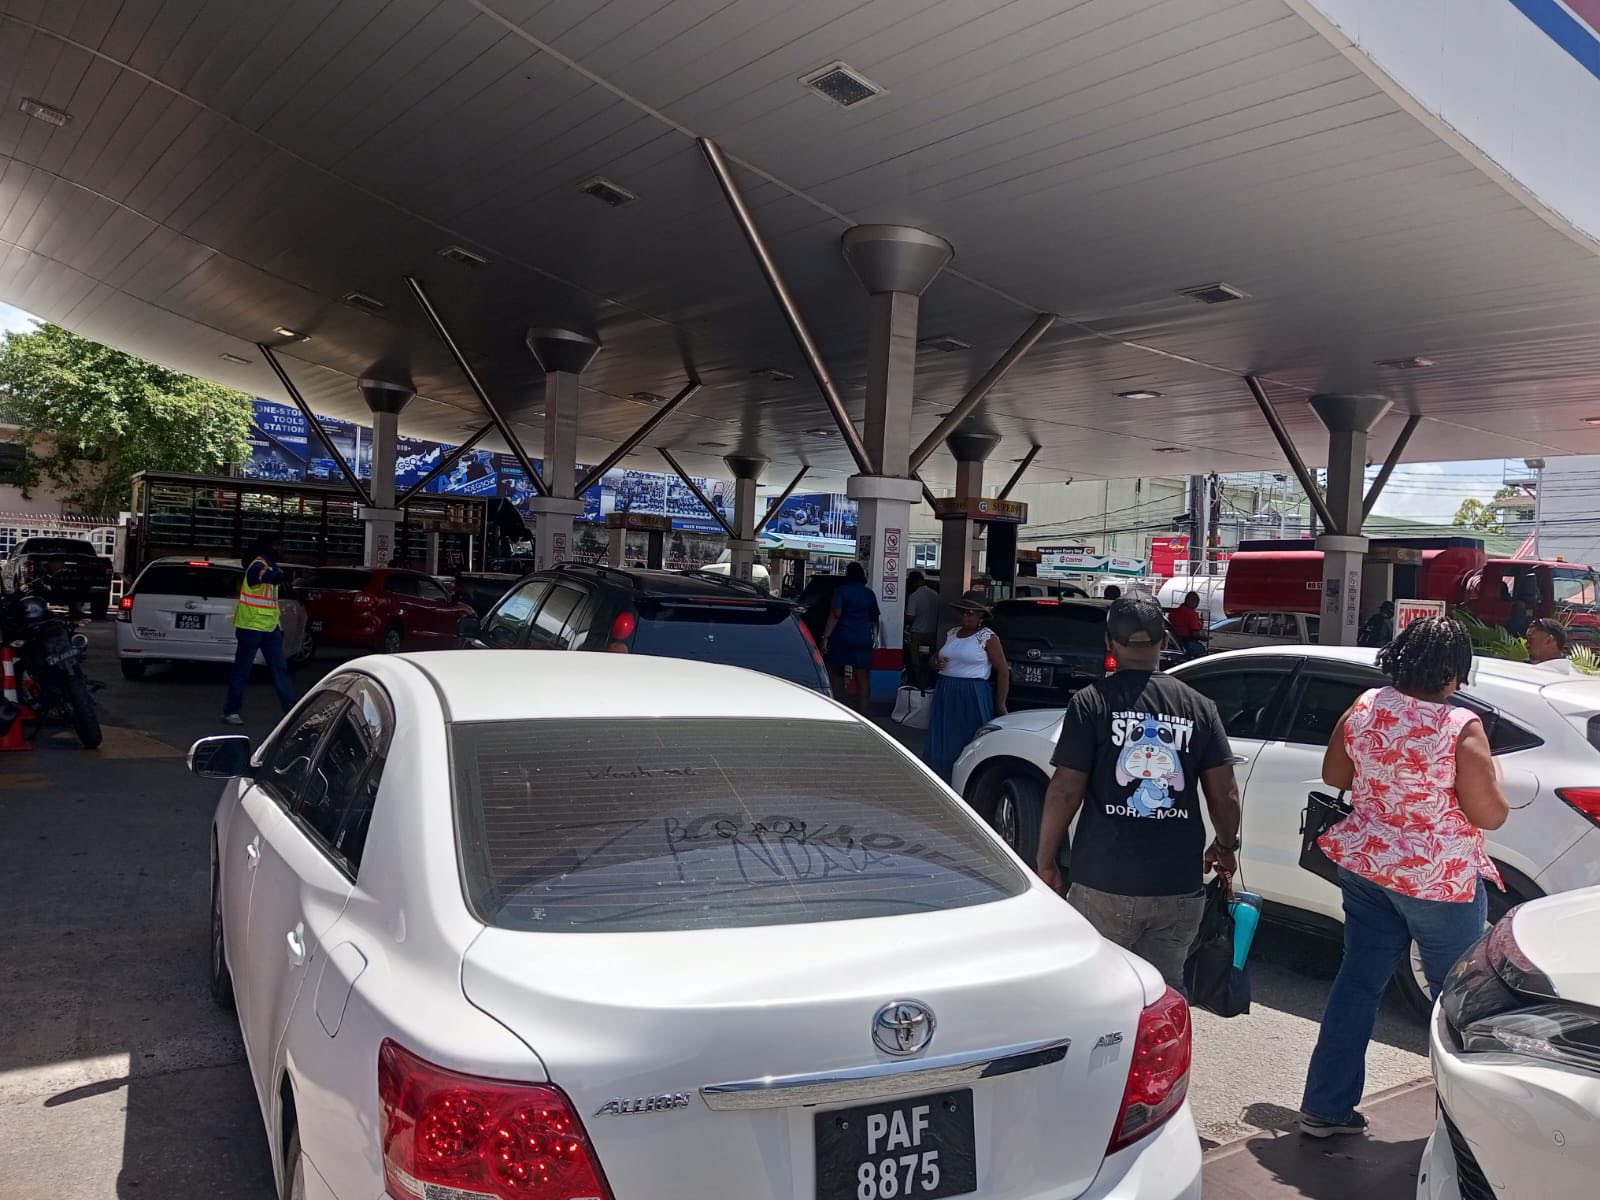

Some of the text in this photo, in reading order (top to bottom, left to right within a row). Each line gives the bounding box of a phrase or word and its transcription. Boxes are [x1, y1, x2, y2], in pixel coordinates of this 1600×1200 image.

[264, 422, 305, 434] STATION
[273, 415, 305, 425] TOOLS
[1105, 804, 1189, 820] DOREMON
[593, 1093, 692, 1118] ALLION
[866, 1104, 930, 1155] PAF
[857, 1149, 940, 1200] 8875
